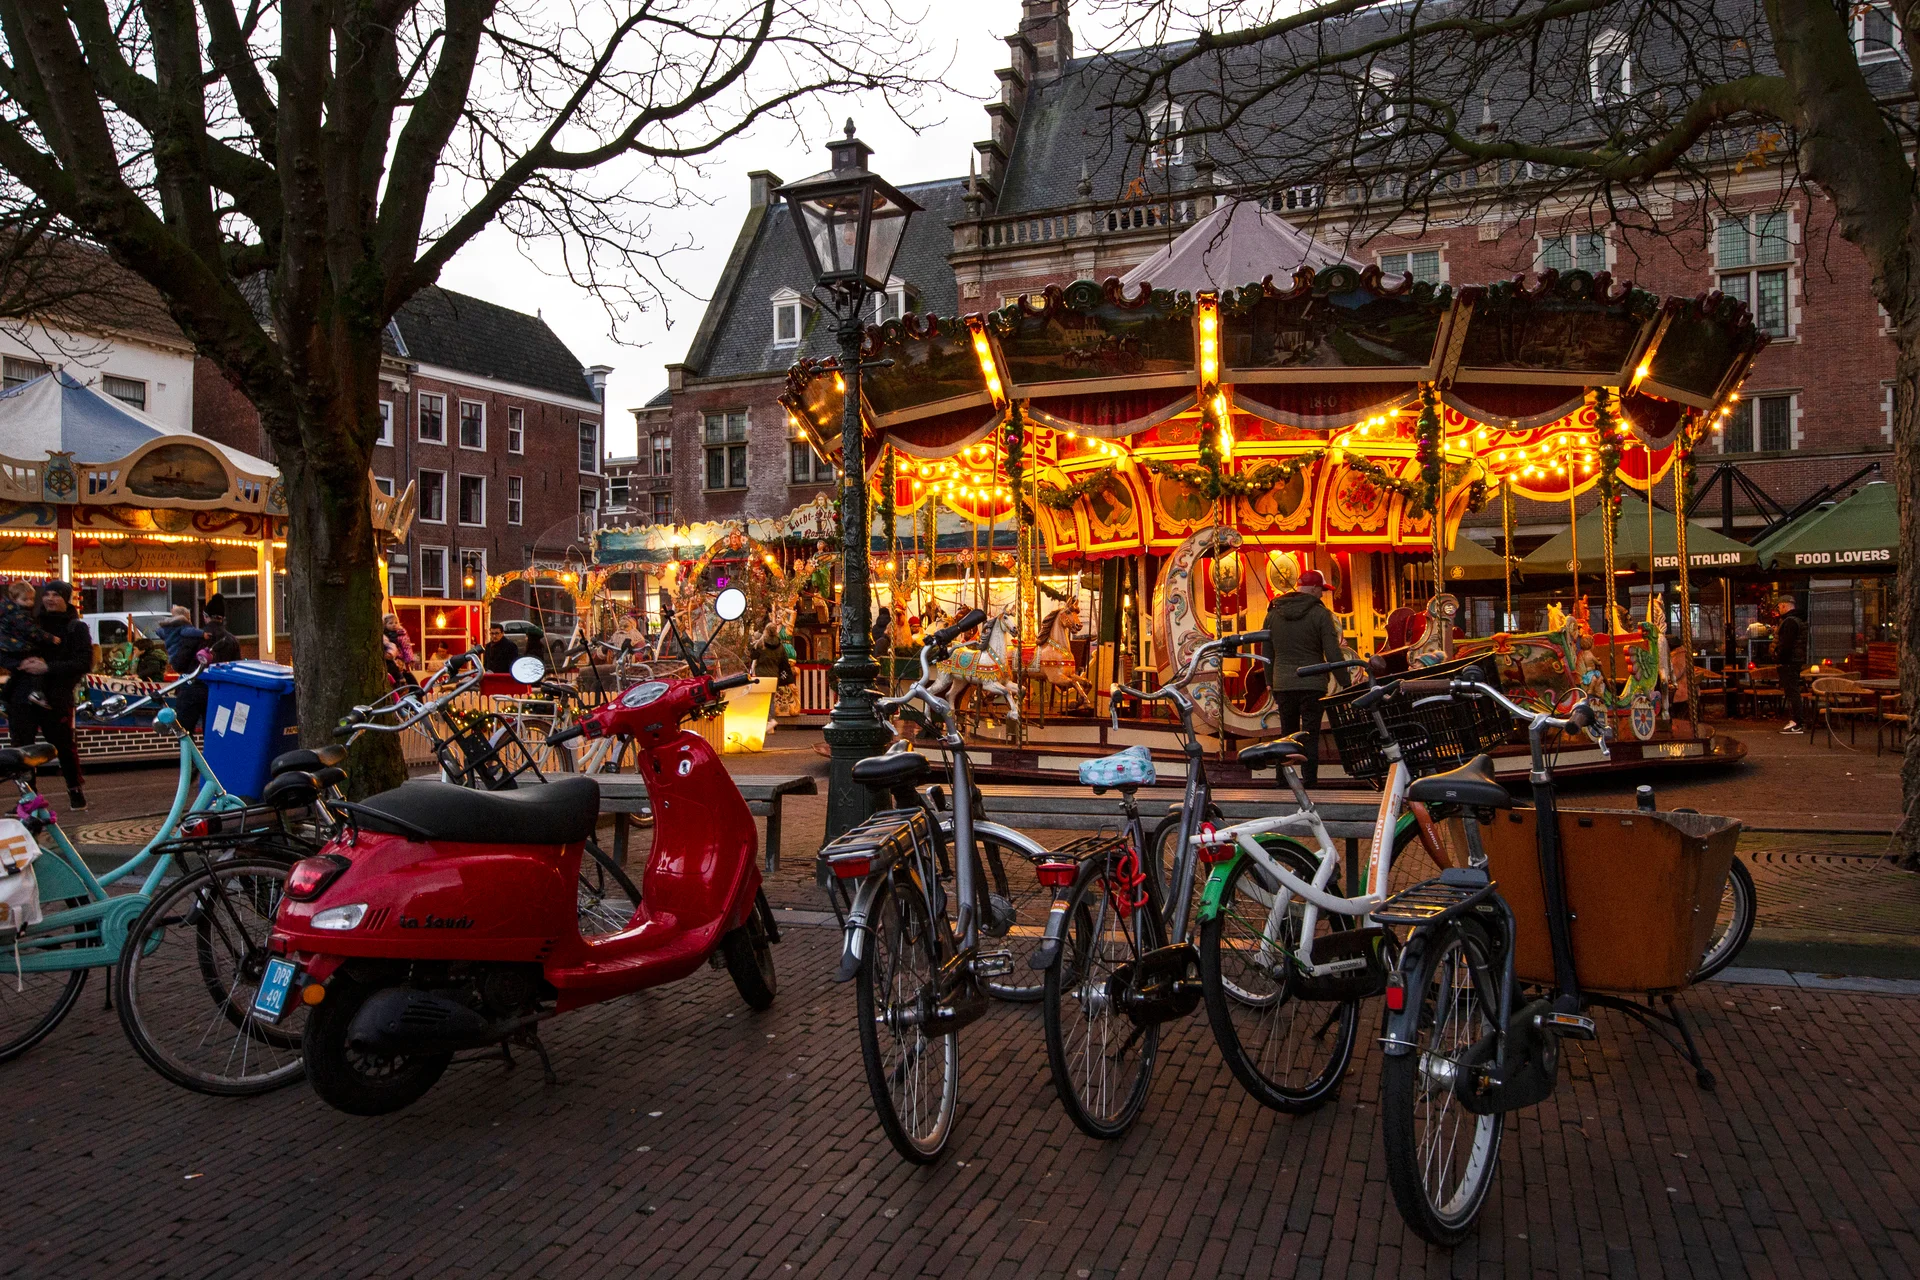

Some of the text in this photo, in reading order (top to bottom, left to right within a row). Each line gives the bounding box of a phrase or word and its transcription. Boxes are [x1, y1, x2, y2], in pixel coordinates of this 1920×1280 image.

[1654, 552, 1741, 567] REA ITALIAN
[1795, 549, 1890, 565] FOOD LOVERS
[103, 577, 167, 588] PASFOTO
[1371, 819, 1383, 865] UNION
[272, 966, 292, 987] DPB
[266, 989, 283, 1009] 49L
